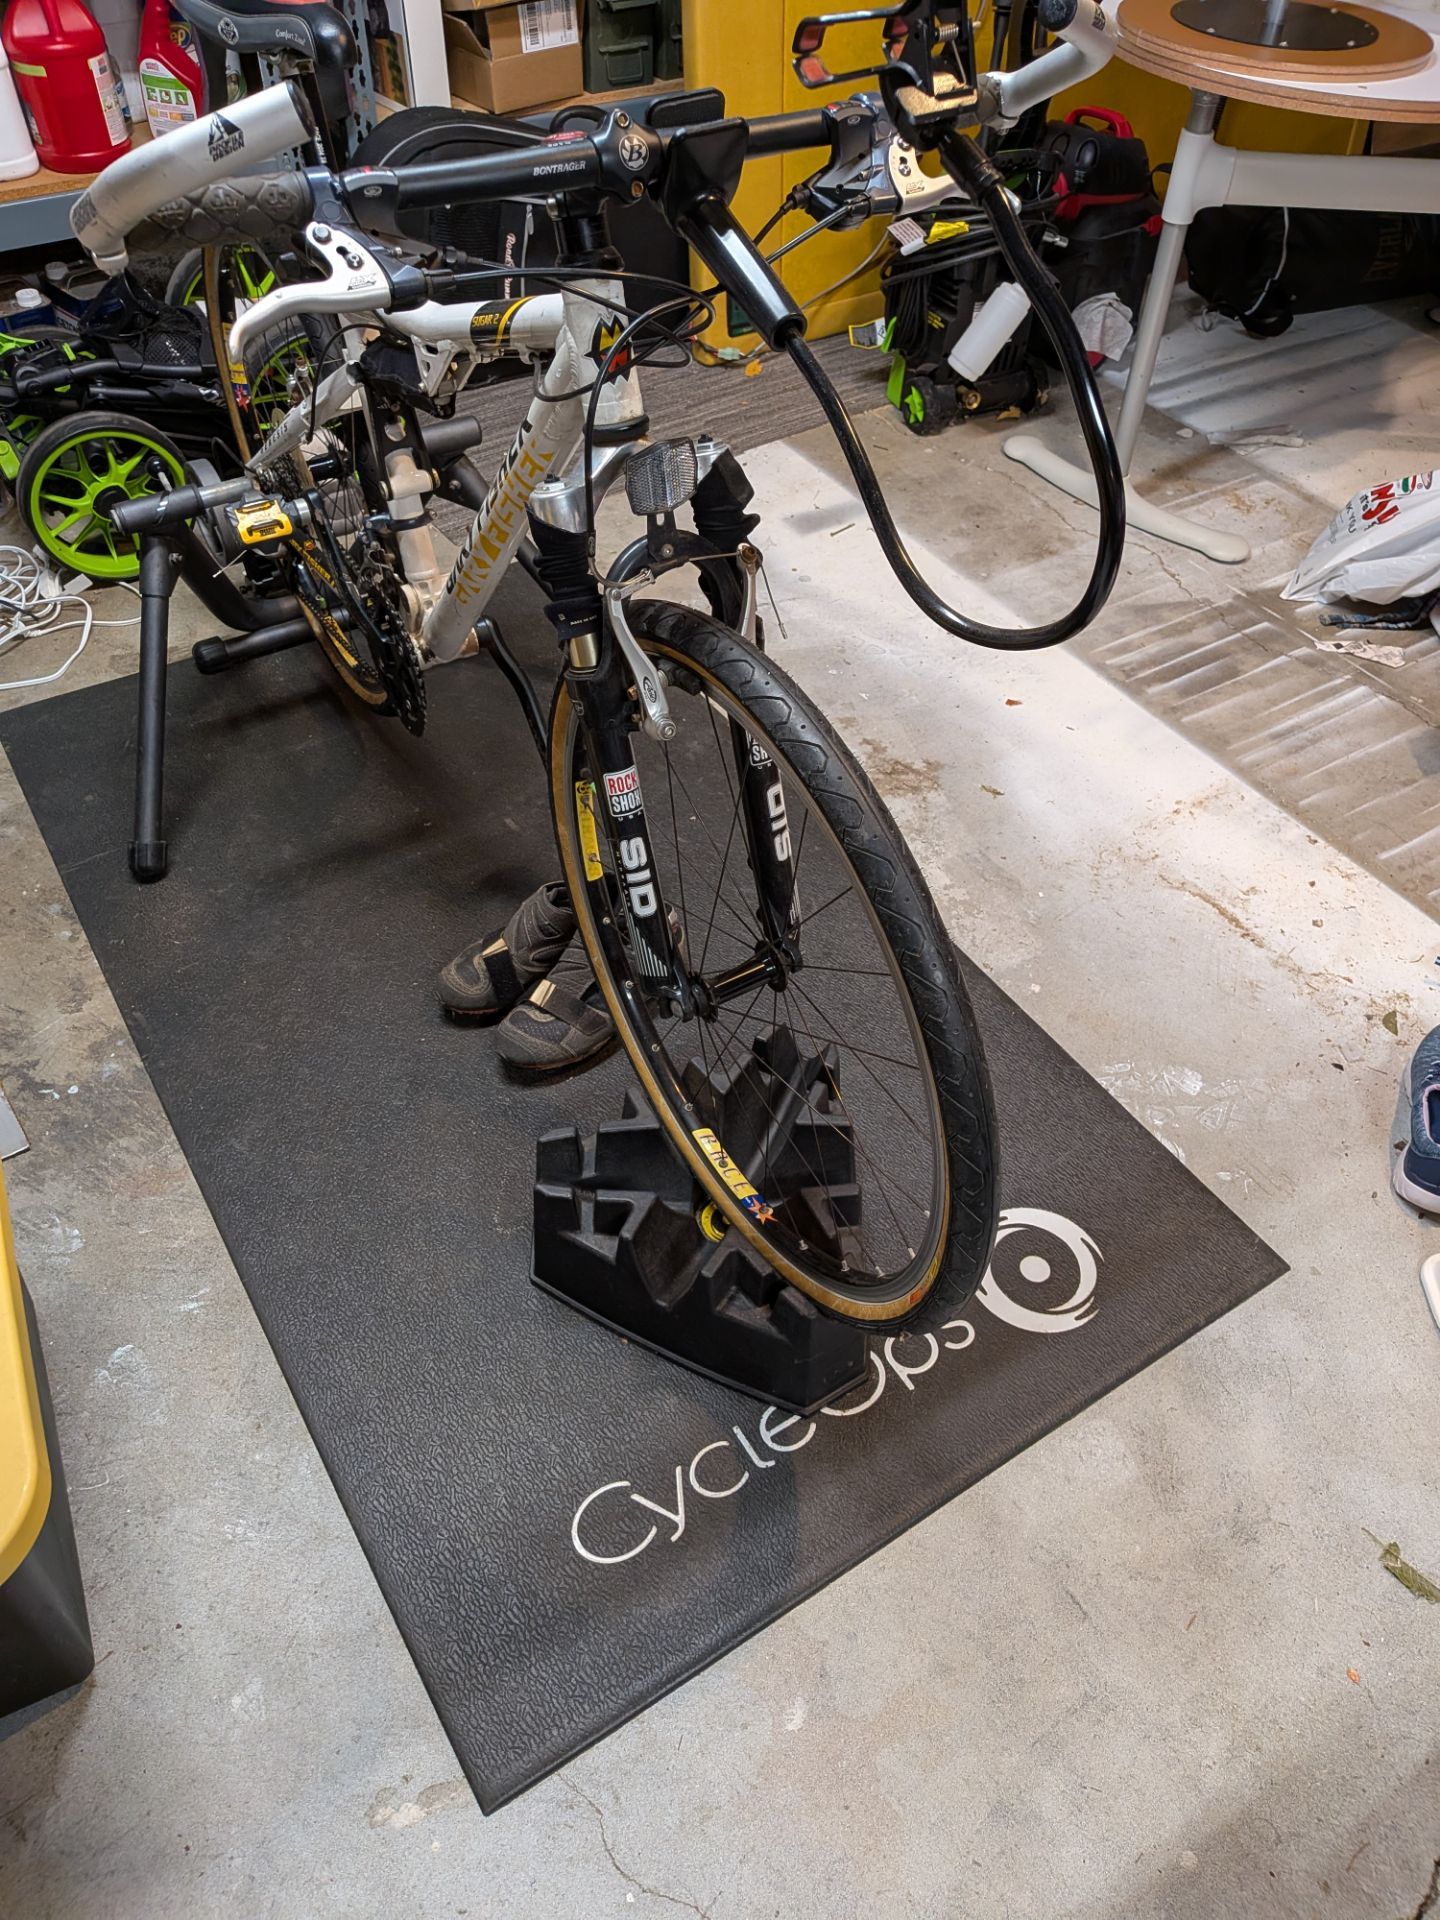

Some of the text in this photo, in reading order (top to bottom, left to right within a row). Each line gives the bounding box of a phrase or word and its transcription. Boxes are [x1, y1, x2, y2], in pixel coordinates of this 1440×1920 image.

[212, 138, 245, 162] DESIGN
[533, 160, 587, 177] BONTRAGER
[472, 314, 493, 328] SUGAR
[608, 770, 638, 795] ROCK
[611, 789, 642, 813] SHOX
[620, 836, 658, 918] SID
